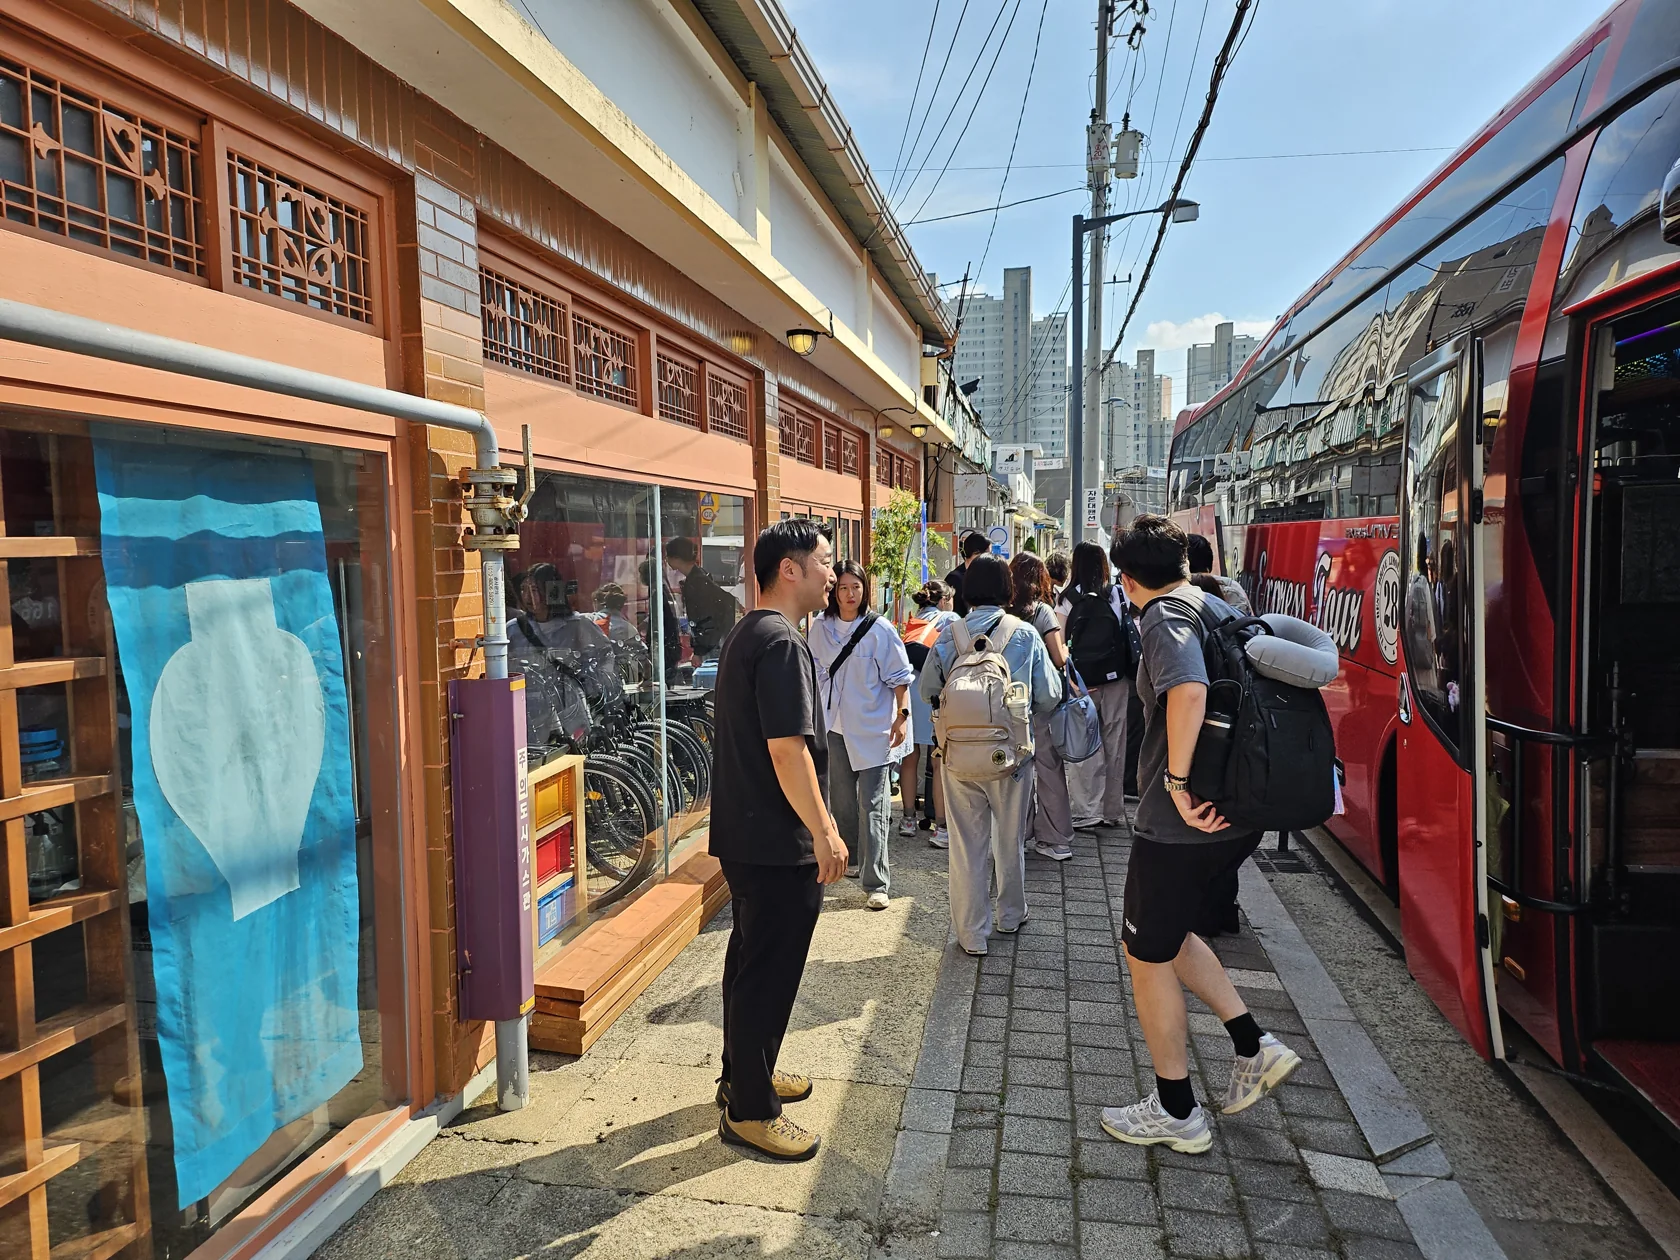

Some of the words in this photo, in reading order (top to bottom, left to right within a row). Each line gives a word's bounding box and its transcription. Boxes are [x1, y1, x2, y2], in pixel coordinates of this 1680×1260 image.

[1308, 550, 1363, 653] Tour
[1384, 580, 1398, 630] 28
[518, 750, 527, 796] 주의
[520, 802, 532, 911] 도시가스관
